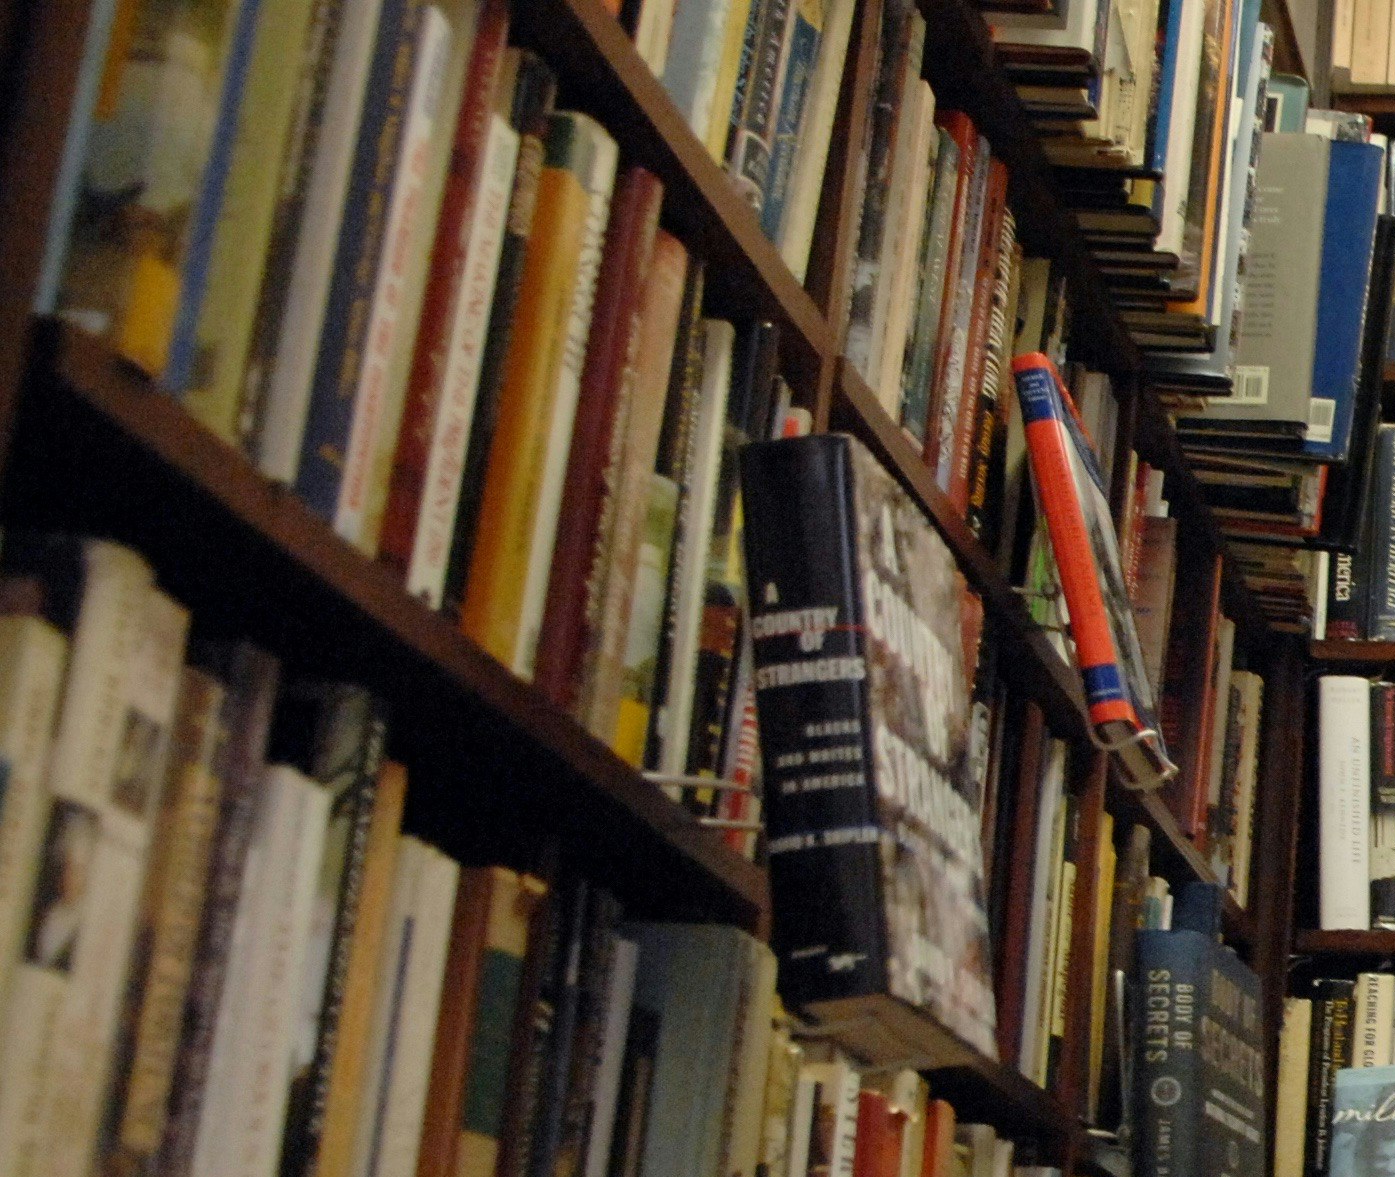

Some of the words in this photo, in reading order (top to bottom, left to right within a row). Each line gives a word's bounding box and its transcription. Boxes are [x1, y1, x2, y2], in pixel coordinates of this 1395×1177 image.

[1335, 554, 1357, 601] merica
[765, 581, 779, 604] A
[753, 606, 838, 639] COUNTRY
[800, 631, 825, 652] OF
[757, 657, 866, 690] STRANGERS
[808, 745, 863, 764] WHITES
[782, 781, 798, 795] IN
[803, 772, 865, 792] AMERICA
[1145, 969, 1170, 1063] SECRETS
[1174, 982, 1194, 1023] BODY
[1174, 1031, 1194, 1050] OF
